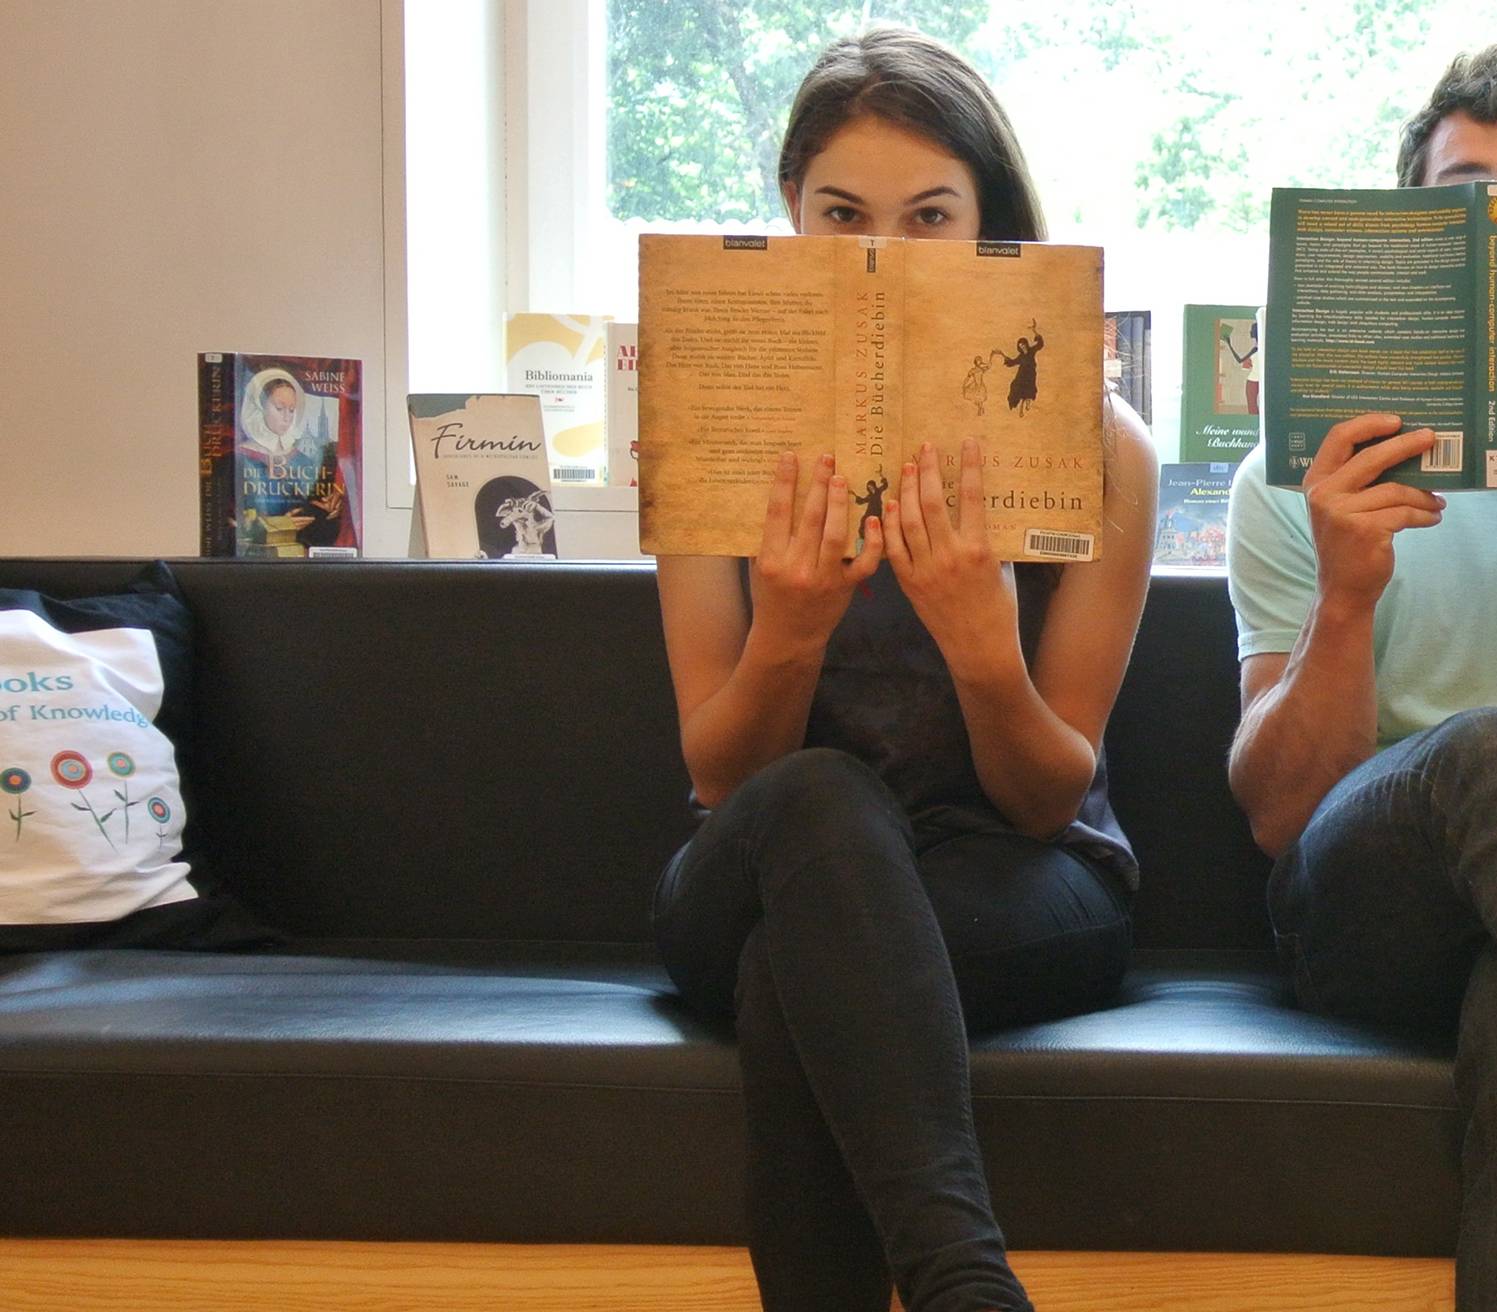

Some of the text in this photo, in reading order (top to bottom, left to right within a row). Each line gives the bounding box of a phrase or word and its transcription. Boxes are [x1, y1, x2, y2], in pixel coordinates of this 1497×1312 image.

[978, 246, 1019, 256] blanvalet
[1488, 235, 1497, 268] beyond
[306, 372, 345, 382] SABINE
[525, 370, 593, 382] Bibliomania
[856, 292, 868, 456] MARKUS ZUSAK
[870, 292, 886, 457] Die Bücherdiebin
[312, 382, 346, 393] WEISS
[431, 423, 542, 459] Firmin
[243, 454, 333, 480] DIE BUCH-
[1014, 456, 1083, 469] ZUSAK
[243, 481, 345, 496] DRUCKERIN
[31, 704, 150, 728] Knowledg
